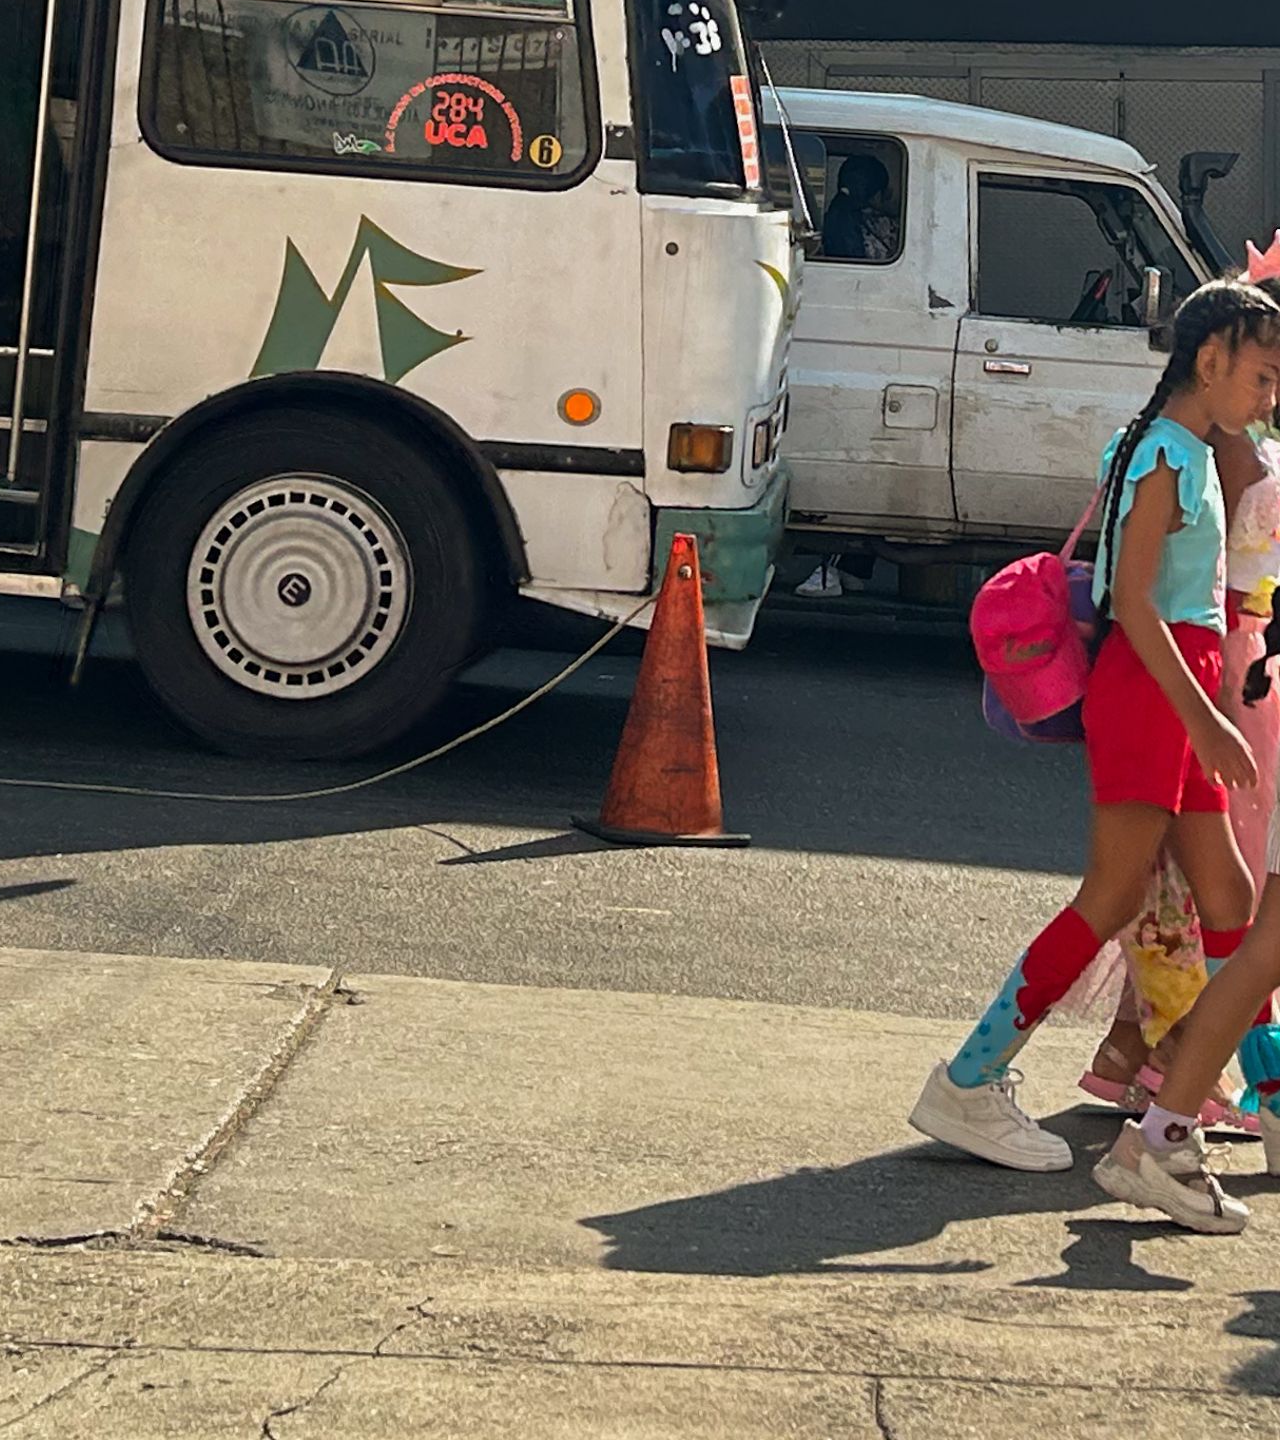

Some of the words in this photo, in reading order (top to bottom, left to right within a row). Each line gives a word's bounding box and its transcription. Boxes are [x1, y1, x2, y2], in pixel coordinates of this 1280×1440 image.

[432, 91, 484, 122] 284
[425, 120, 488, 149] UCA
[538, 137, 554, 165] 6
